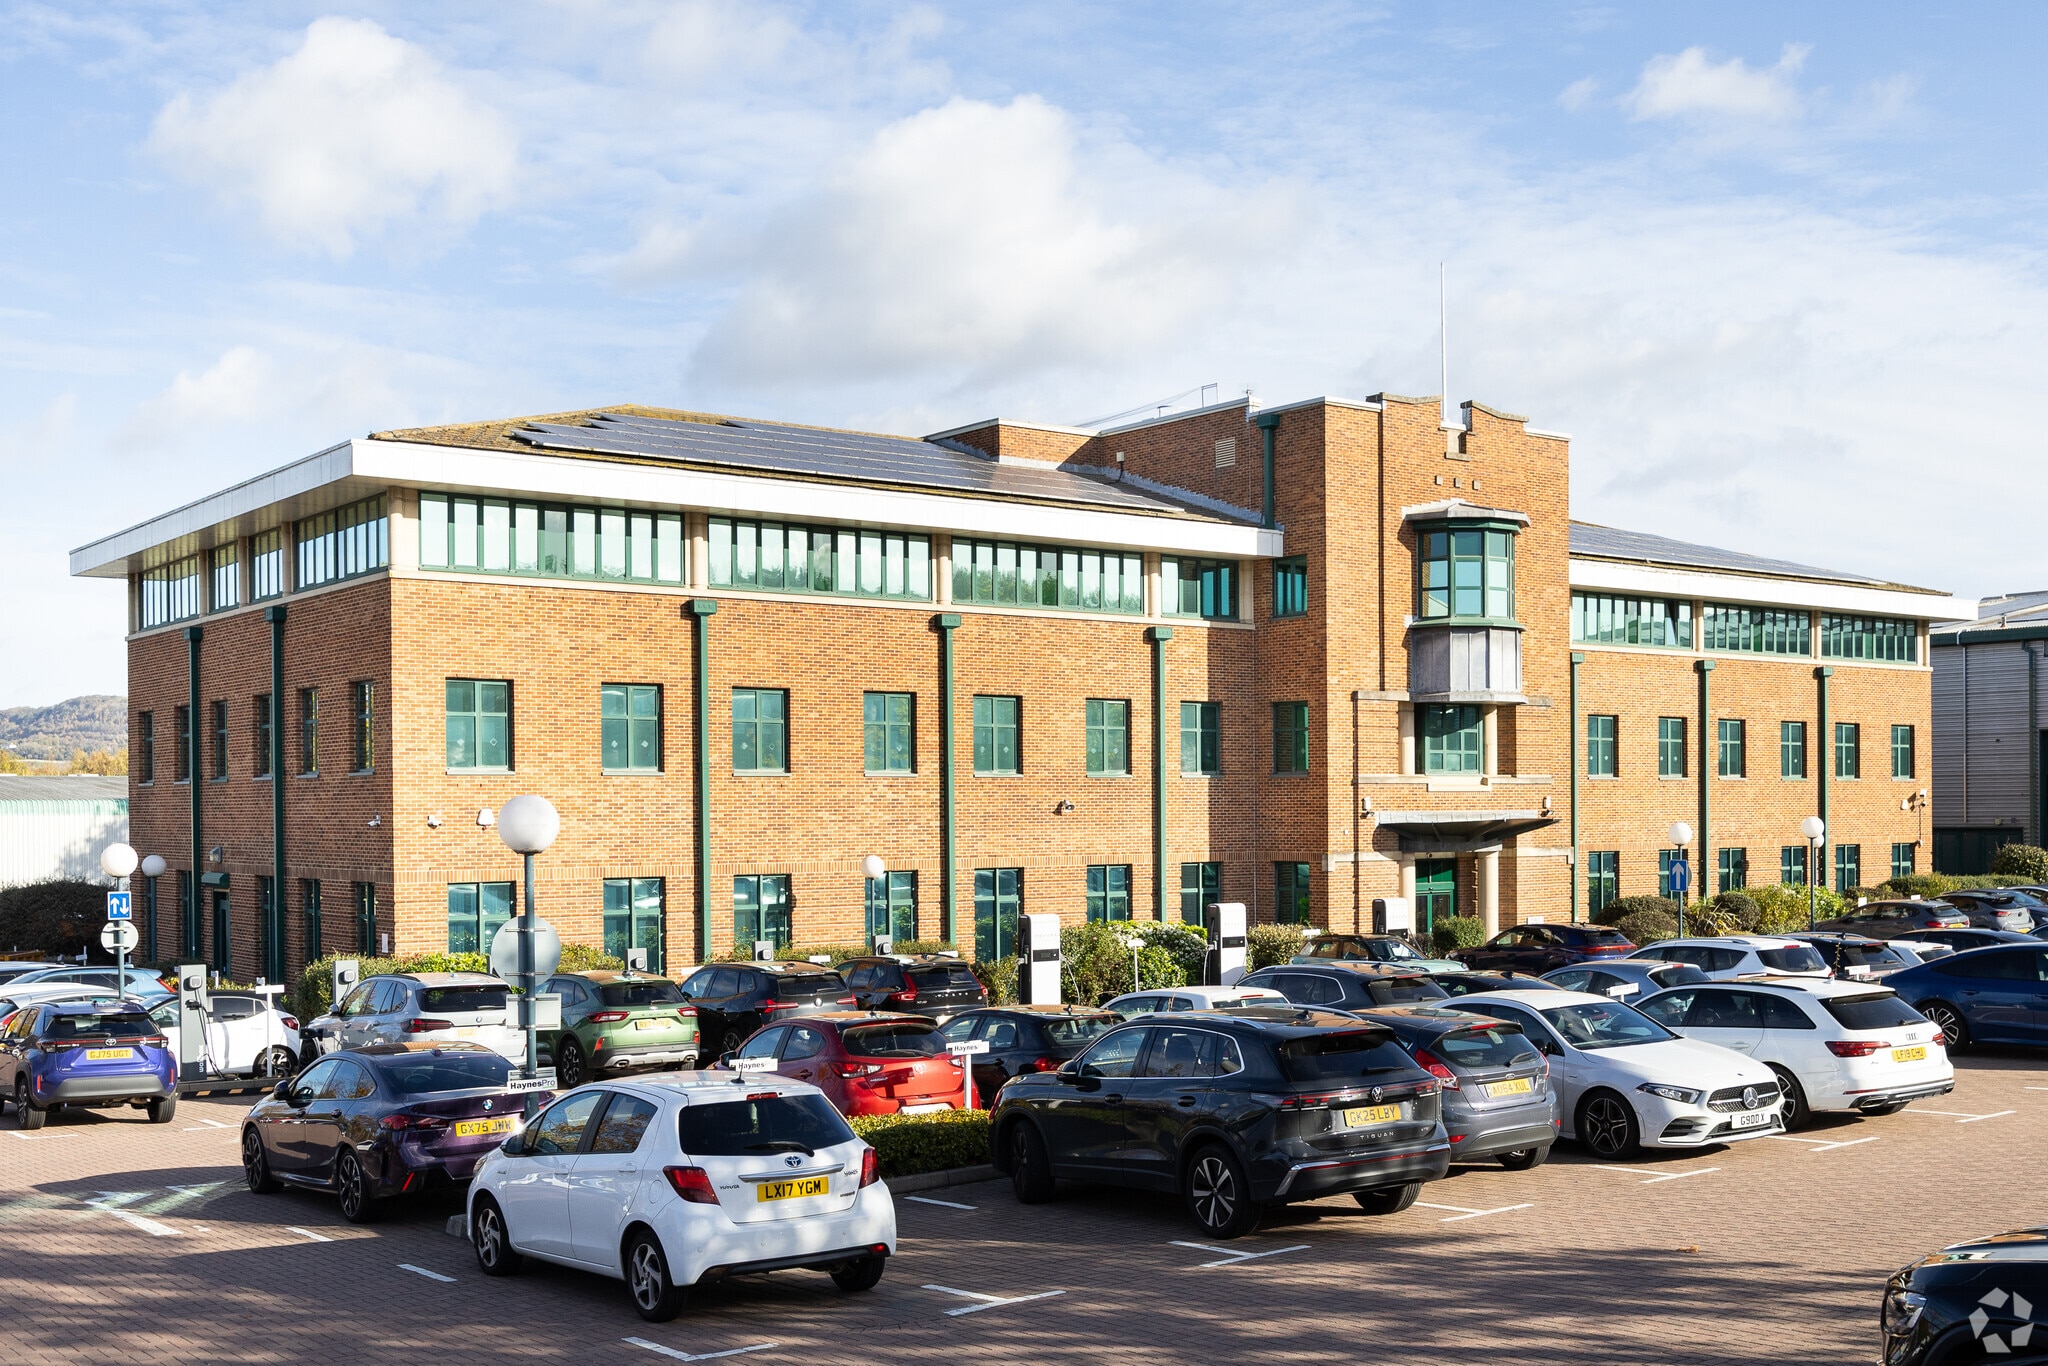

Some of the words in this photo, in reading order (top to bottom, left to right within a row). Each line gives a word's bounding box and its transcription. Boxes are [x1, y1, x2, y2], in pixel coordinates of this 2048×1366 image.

[954, 1043, 983, 1052] Haynes
[90, 1051, 112, 1059] GJ75
[113, 1050, 130, 1058] UGT
[738, 1061, 771, 1070] Haynes
[510, 1079, 556, 1090] HaynesPro
[1514, 1080, 1529, 1092] XUL
[1350, 1110, 1376, 1122] GK25
[1377, 1107, 1396, 1119] LBY
[1760, 1113, 1765, 1122] X
[460, 1122, 489, 1134] GX75
[1360, 1131, 1394, 1140] TIGUAN
[765, 1183, 793, 1199] LX17
[797, 1180, 821, 1195] YGM
